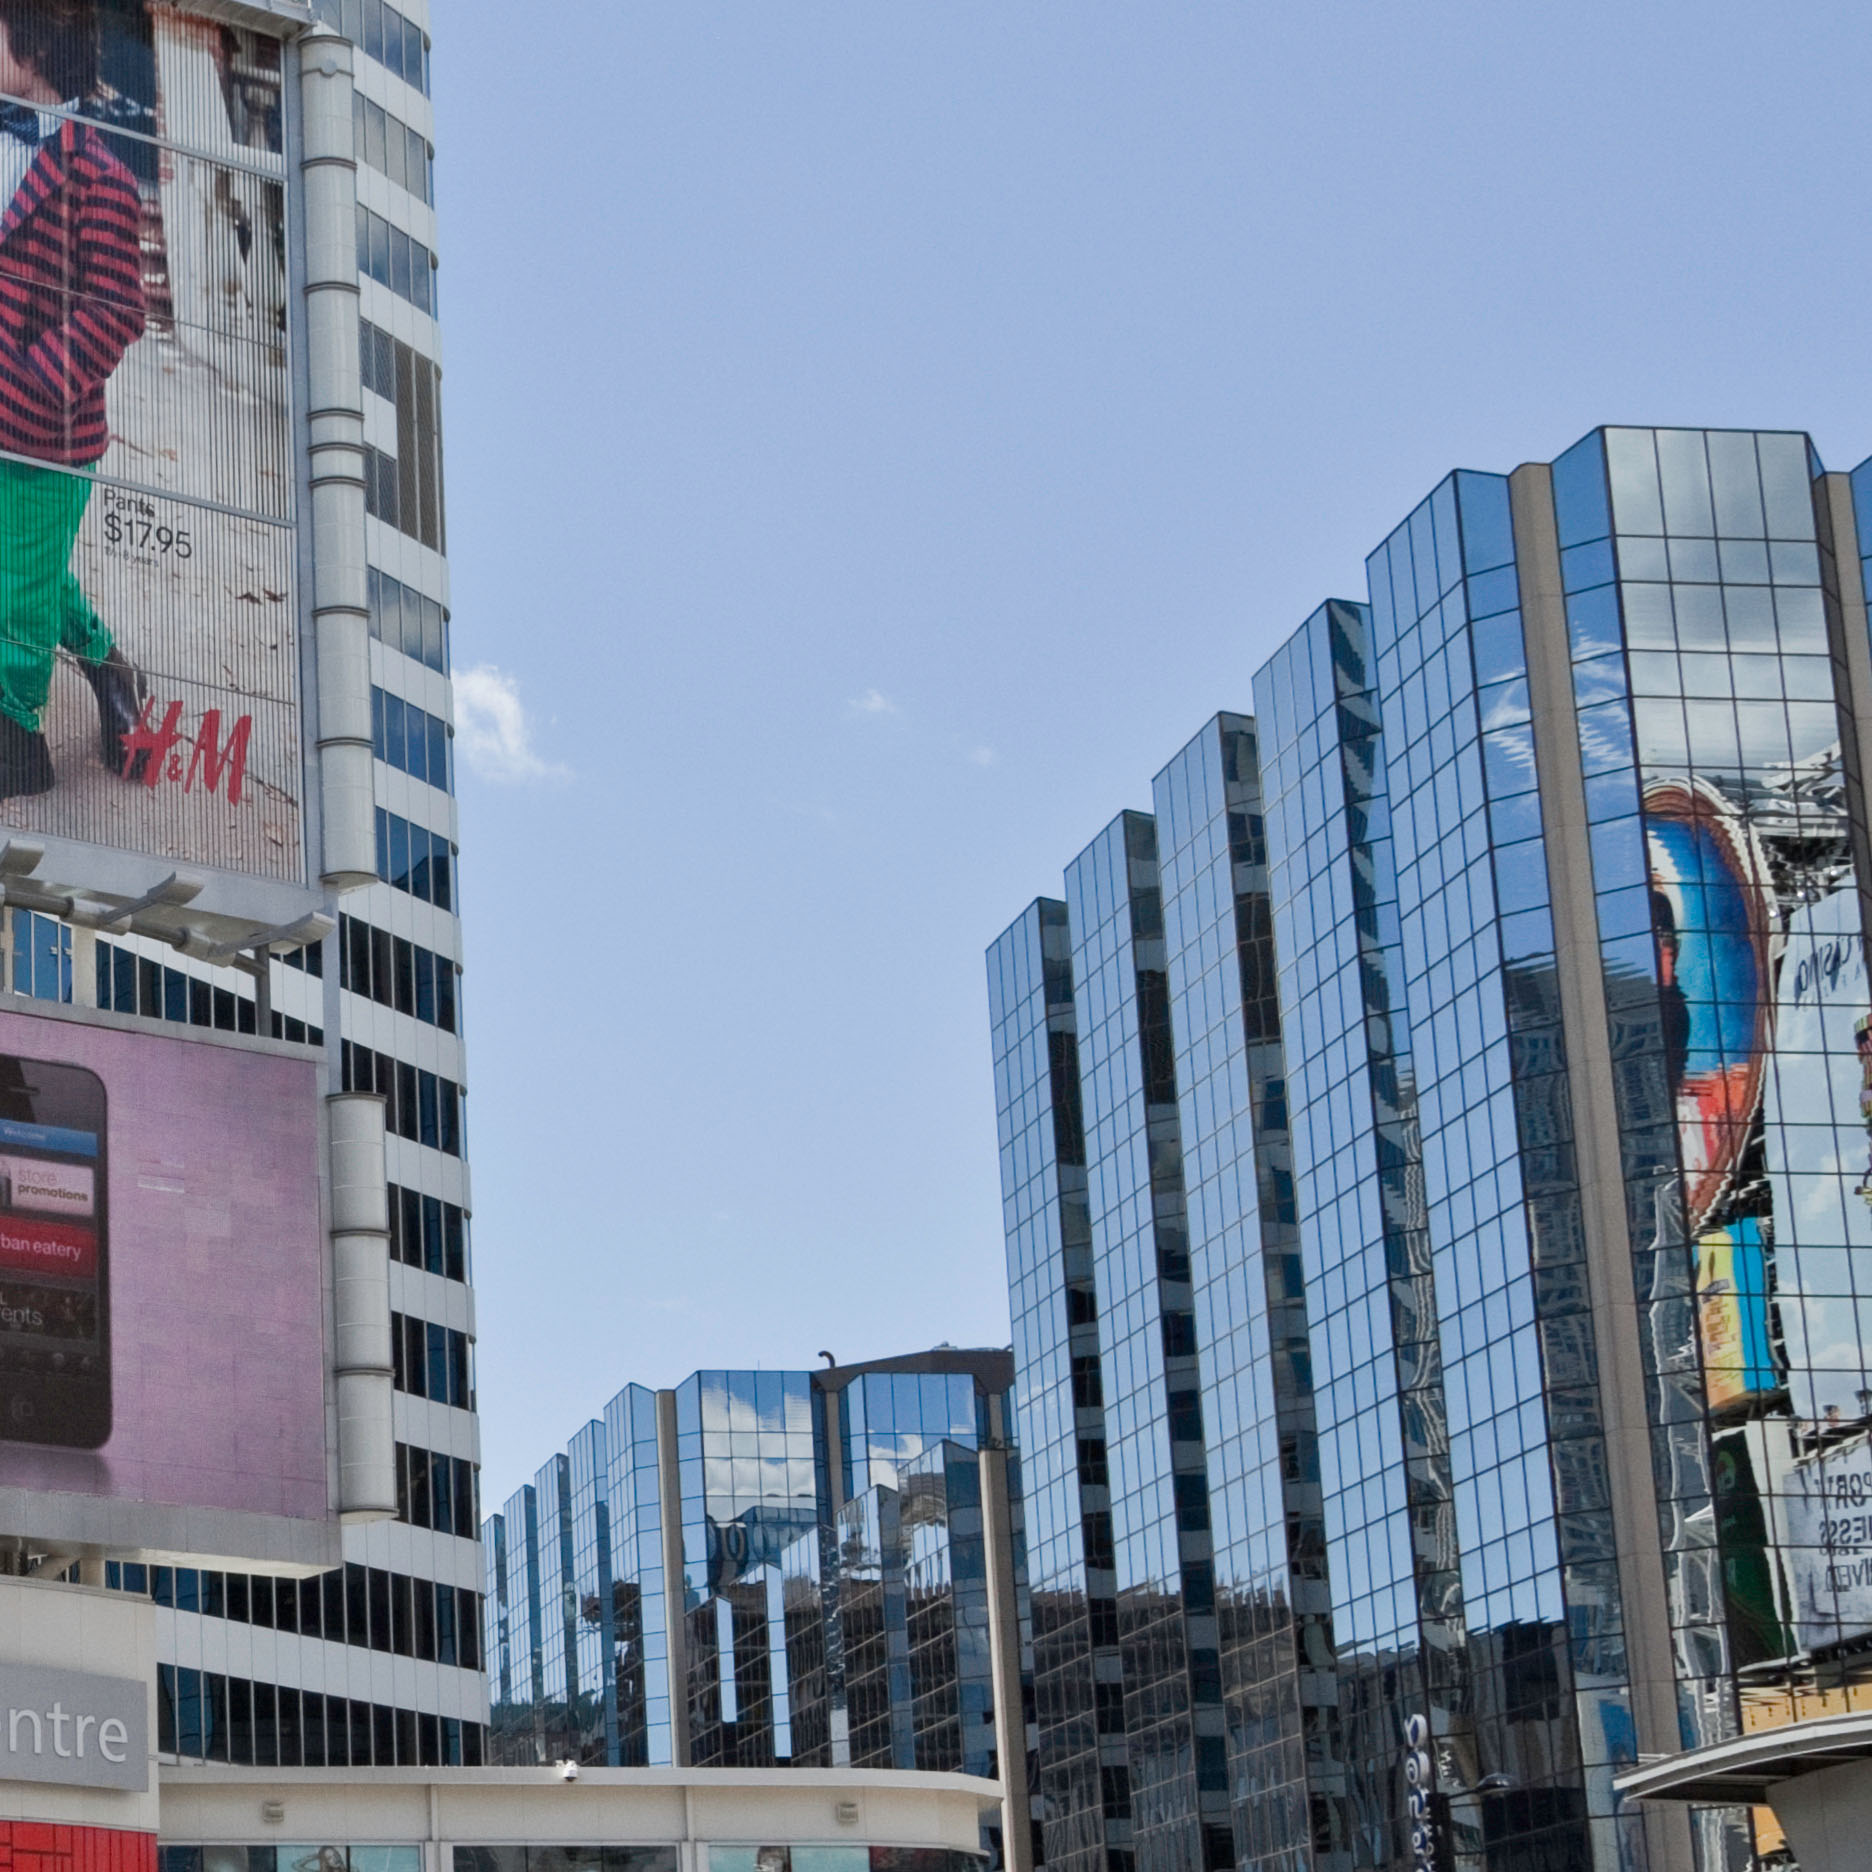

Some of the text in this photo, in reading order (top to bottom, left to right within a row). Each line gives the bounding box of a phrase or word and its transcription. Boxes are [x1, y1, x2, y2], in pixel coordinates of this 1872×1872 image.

[104, 488, 155, 517] Pants
[104, 511, 192, 559] $17.95
[120, 696, 253, 805] H&M
[18, 1168, 58, 1184] store
[18, 1183, 88, 1202] promotions
[33, 1241, 81, 1262] eatery
